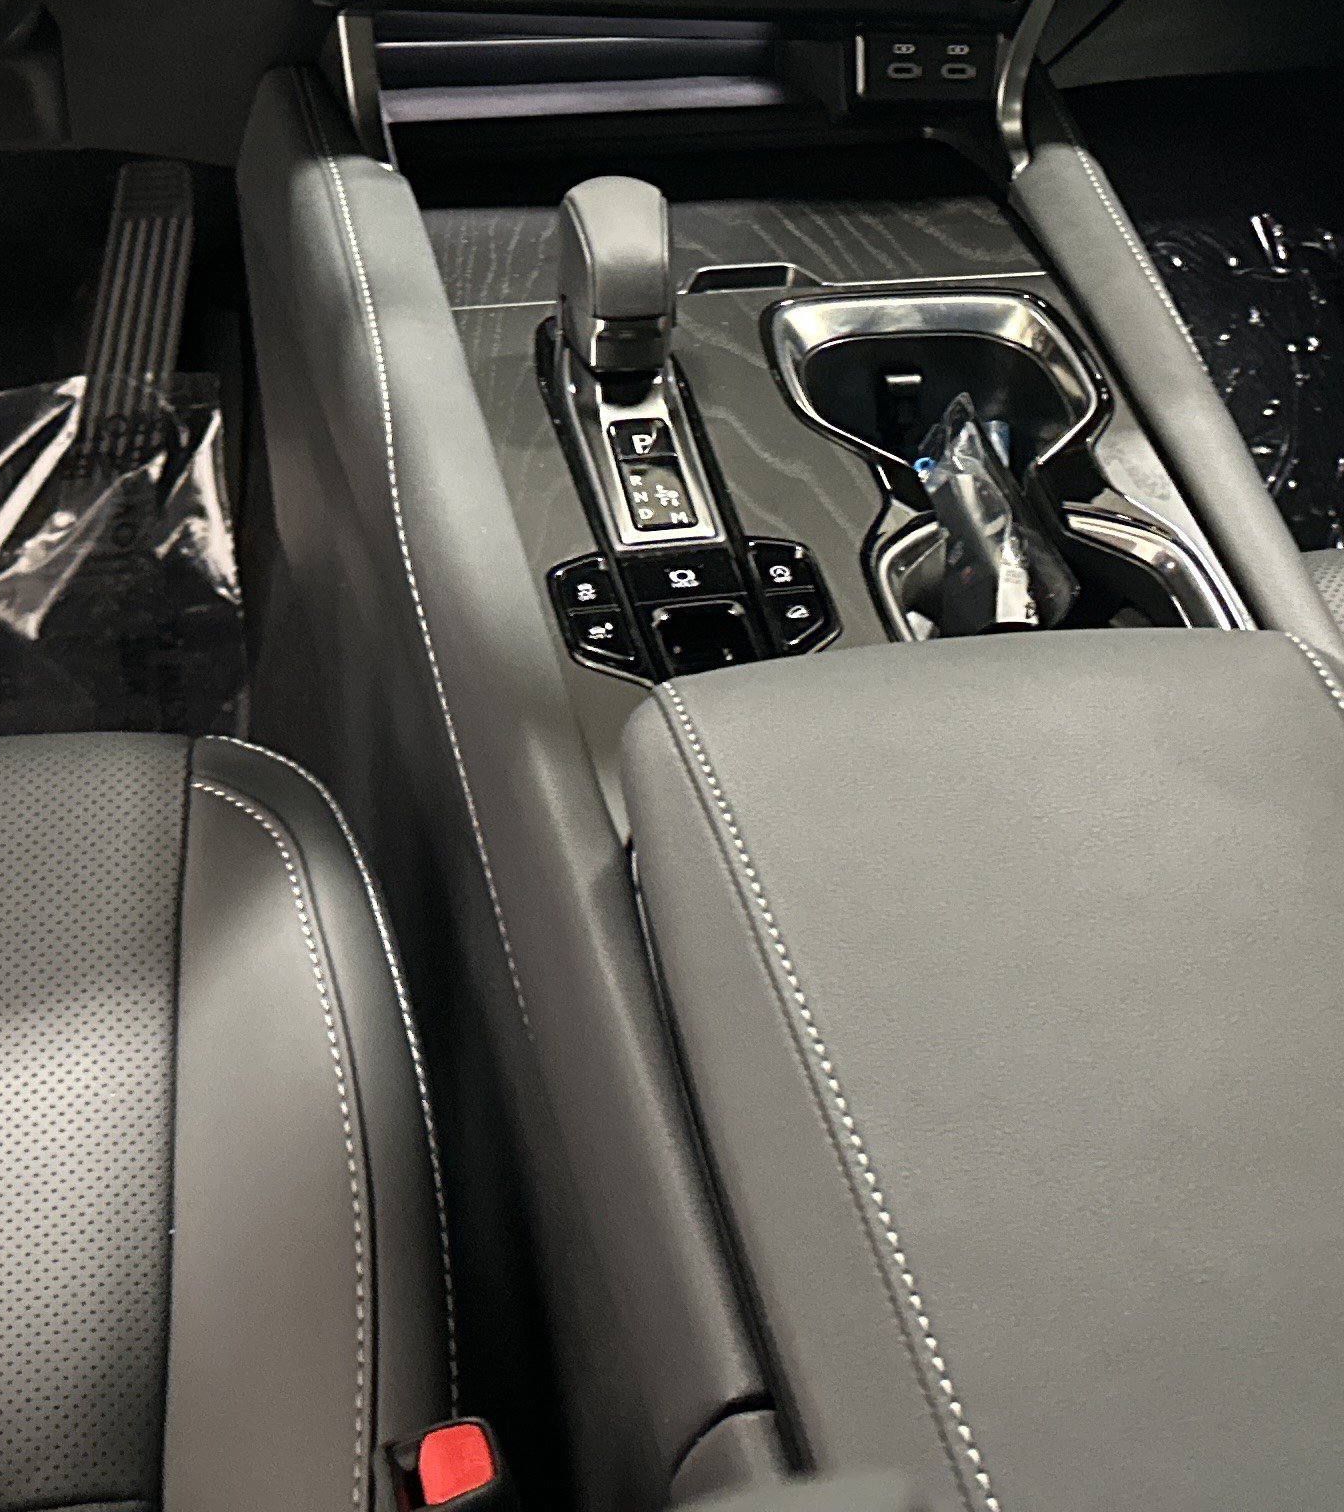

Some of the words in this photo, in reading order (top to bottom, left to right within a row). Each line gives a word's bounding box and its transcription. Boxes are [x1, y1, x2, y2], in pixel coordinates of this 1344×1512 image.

[631, 434, 654, 455] P
[629, 475, 642, 486] R
[633, 491, 649, 503] N
[637, 508, 654, 520] D
[670, 511, 689, 524] M
